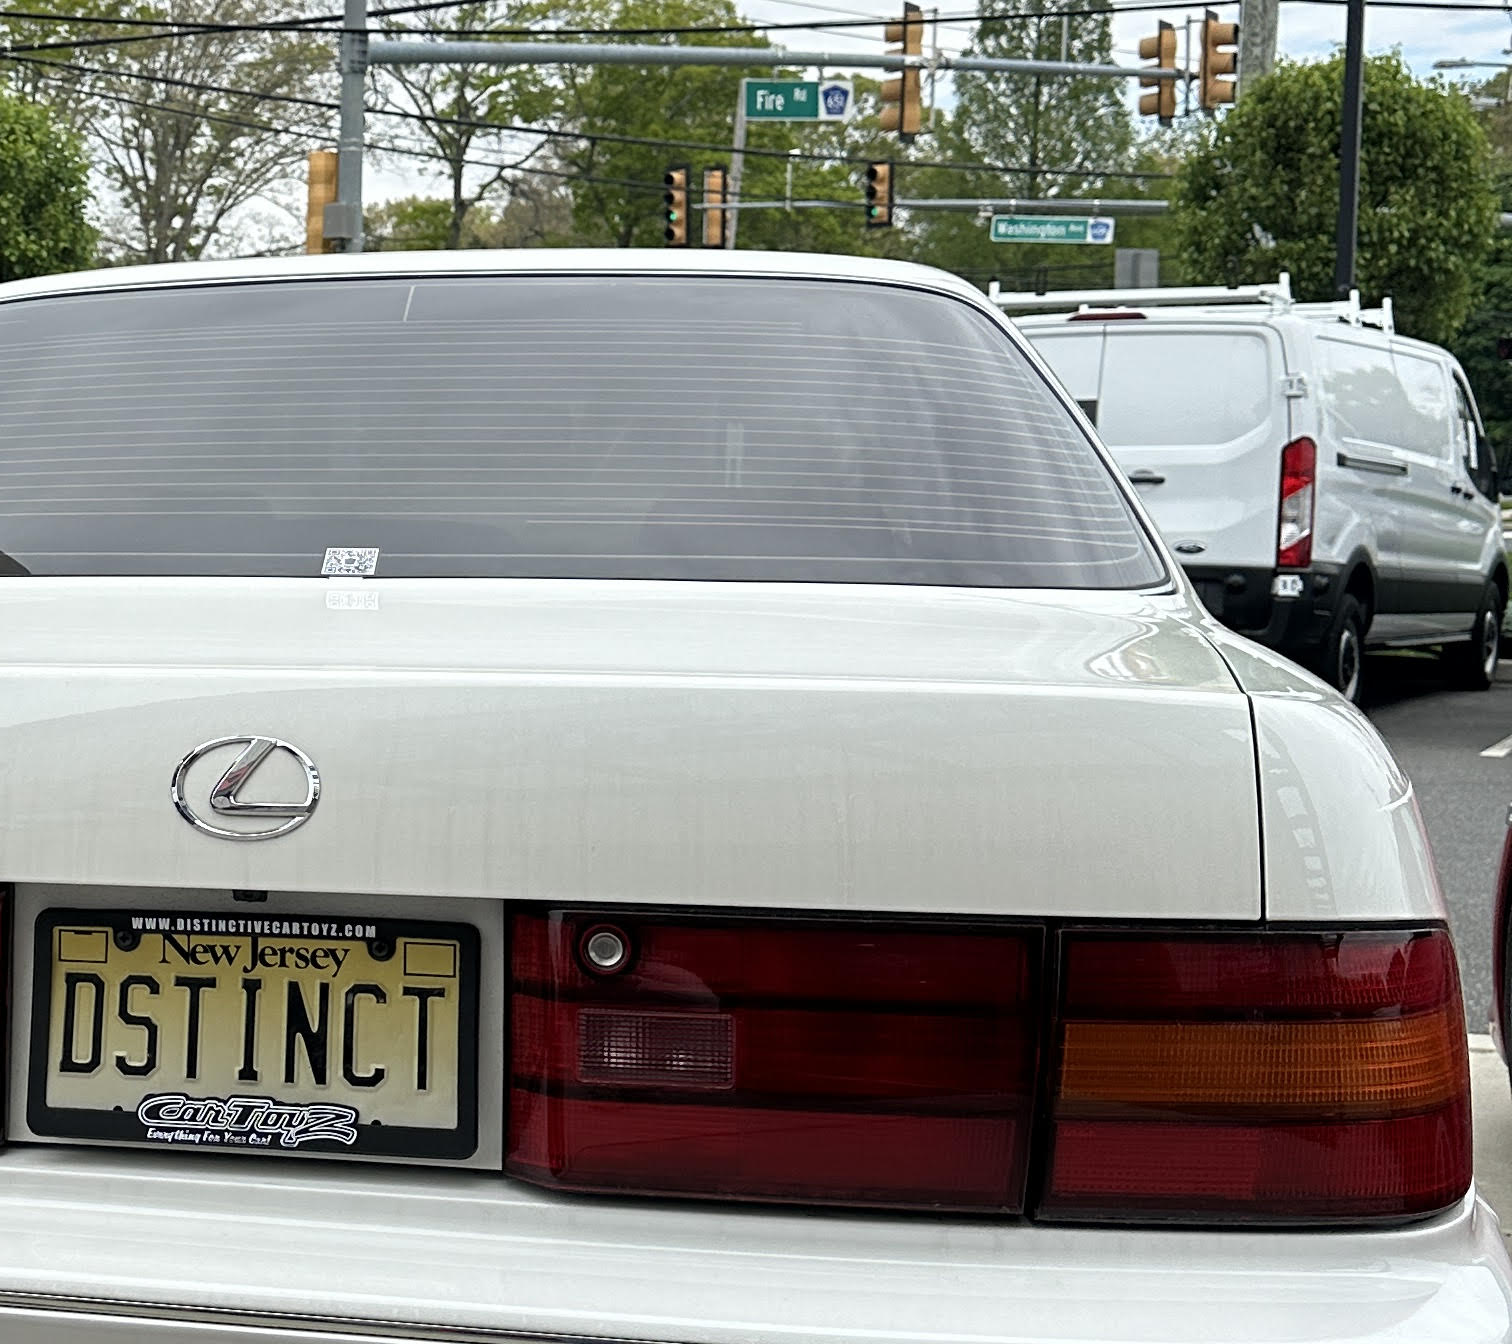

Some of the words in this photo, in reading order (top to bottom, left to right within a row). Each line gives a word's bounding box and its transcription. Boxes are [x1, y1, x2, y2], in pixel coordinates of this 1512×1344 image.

[756, 89, 785, 111] Fire
[793, 87, 808, 102] Rd
[996, 221, 1067, 239] Washington
[131, 917, 376, 938] WWW.DISTINCTIVECARTOYZ.COM
[158, 934, 242, 965] New
[243, 936, 351, 977] Jersey
[59, 972, 446, 1091] DSTINCT
[147, 1127, 202, 1143] Everything
[202, 1131, 220, 1142] For
[223, 1131, 247, 1143] Your
